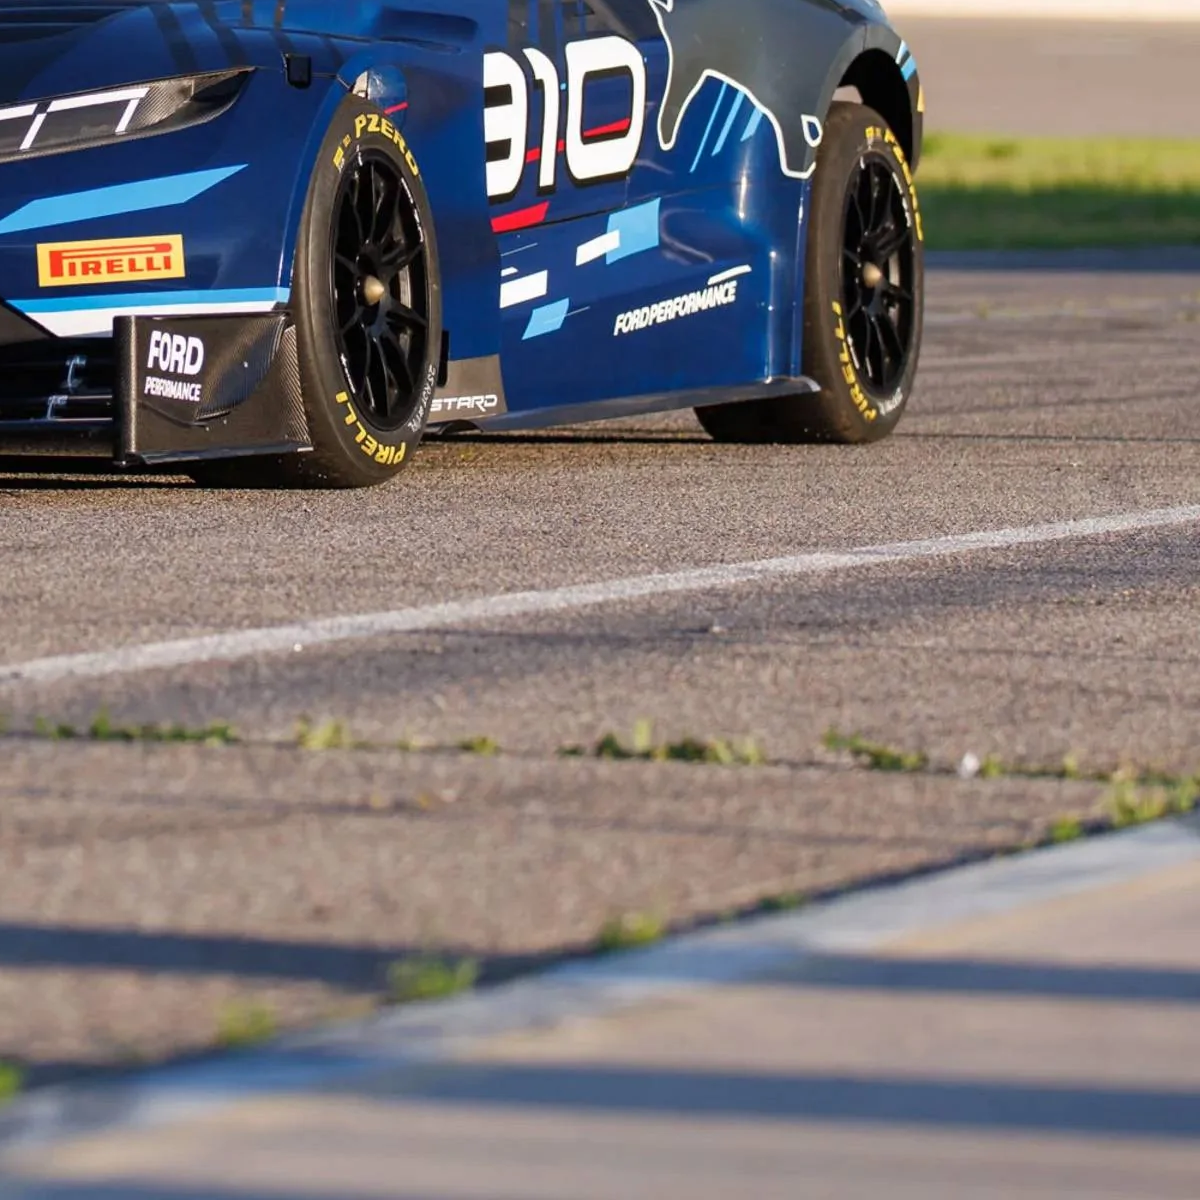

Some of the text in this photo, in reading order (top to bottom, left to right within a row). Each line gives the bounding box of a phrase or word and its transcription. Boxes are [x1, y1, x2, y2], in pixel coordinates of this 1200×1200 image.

[49, 243, 173, 278] PIRELLI
[147, 330, 205, 376] FORD
[144, 376, 202, 402] PERFORMANCE
[429, 394, 498, 412] STARD
[335, 391, 406, 465] PIRELLI
